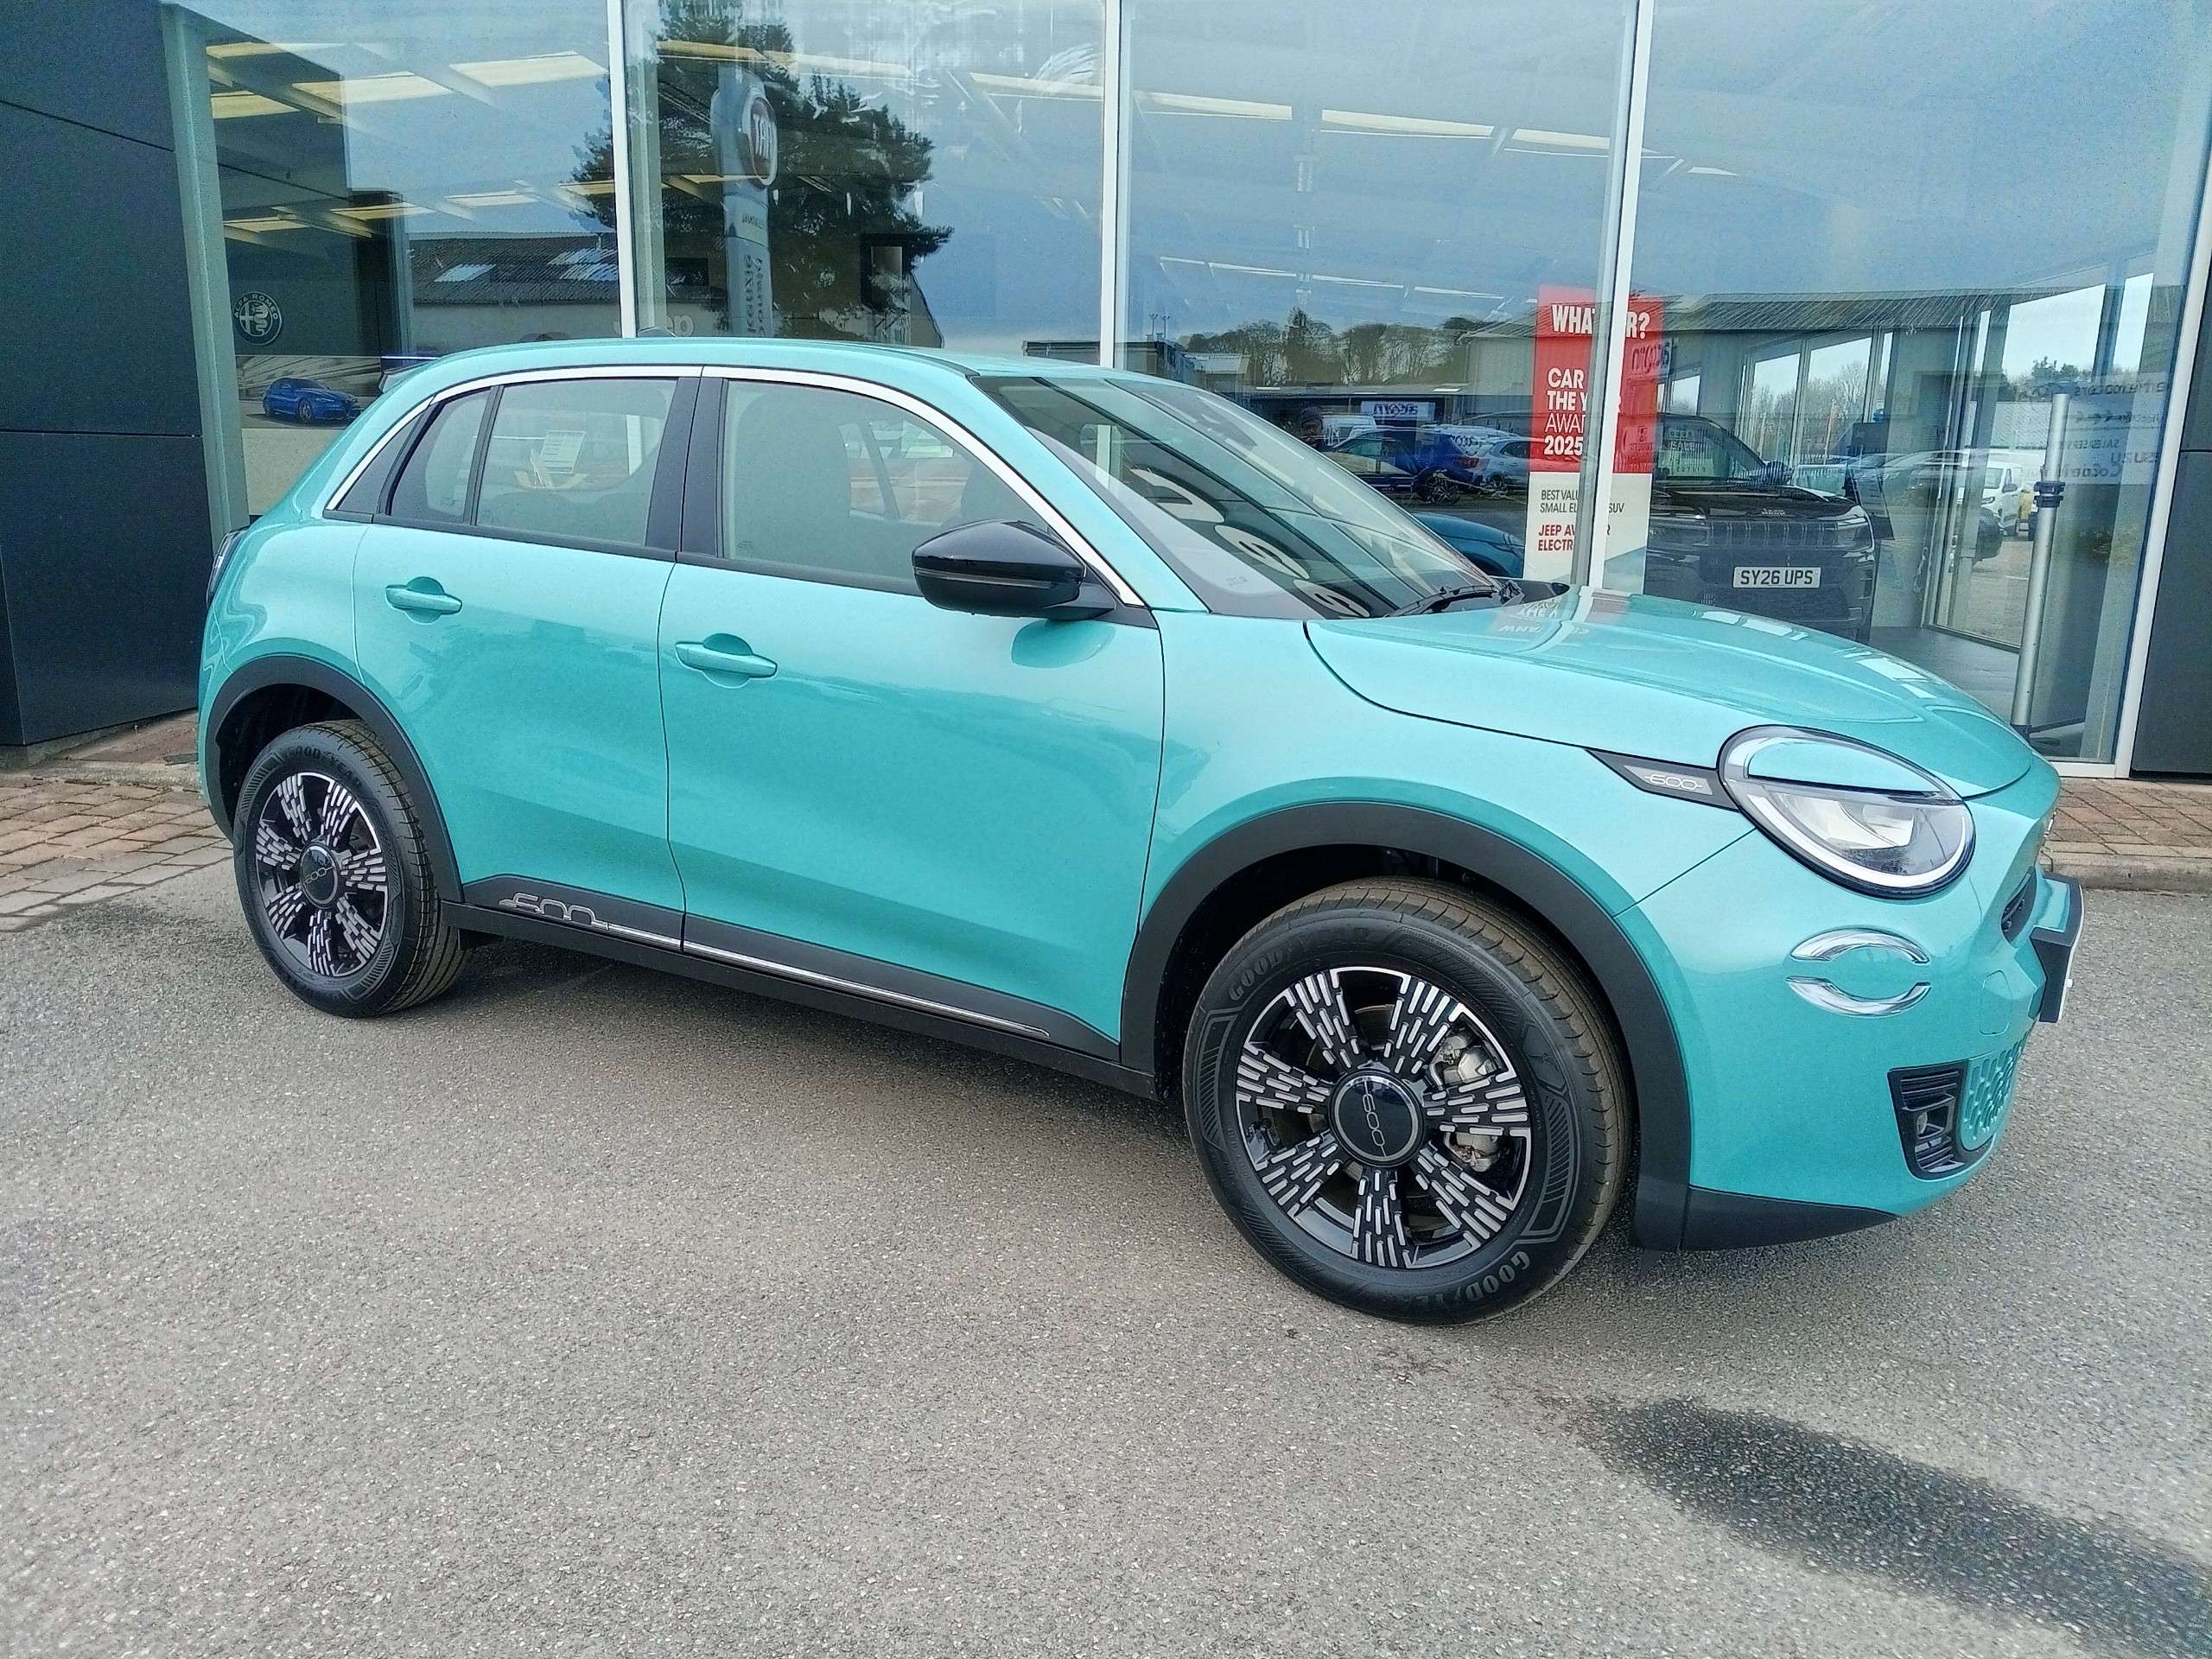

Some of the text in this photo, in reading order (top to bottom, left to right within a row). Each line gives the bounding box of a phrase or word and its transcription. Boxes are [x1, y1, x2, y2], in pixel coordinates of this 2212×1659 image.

[1551, 304, 1595, 334] WHA
[1548, 367, 1585, 389] CAR
[1547, 391, 1576, 410] THE
[1544, 435, 1583, 455] 2025
[1541, 490, 1580, 500] BEST VALU
[1540, 503, 1567, 513] SMALL
[1608, 503, 1624, 513] SUV
[1538, 524, 1562, 537] JEEP
[1538, 539, 1573, 551] ELECTR
[1740, 570, 1813, 585] SY26 UPS
[1644, 773, 1703, 791] 600
[1362, 1087, 1386, 1153] 600
